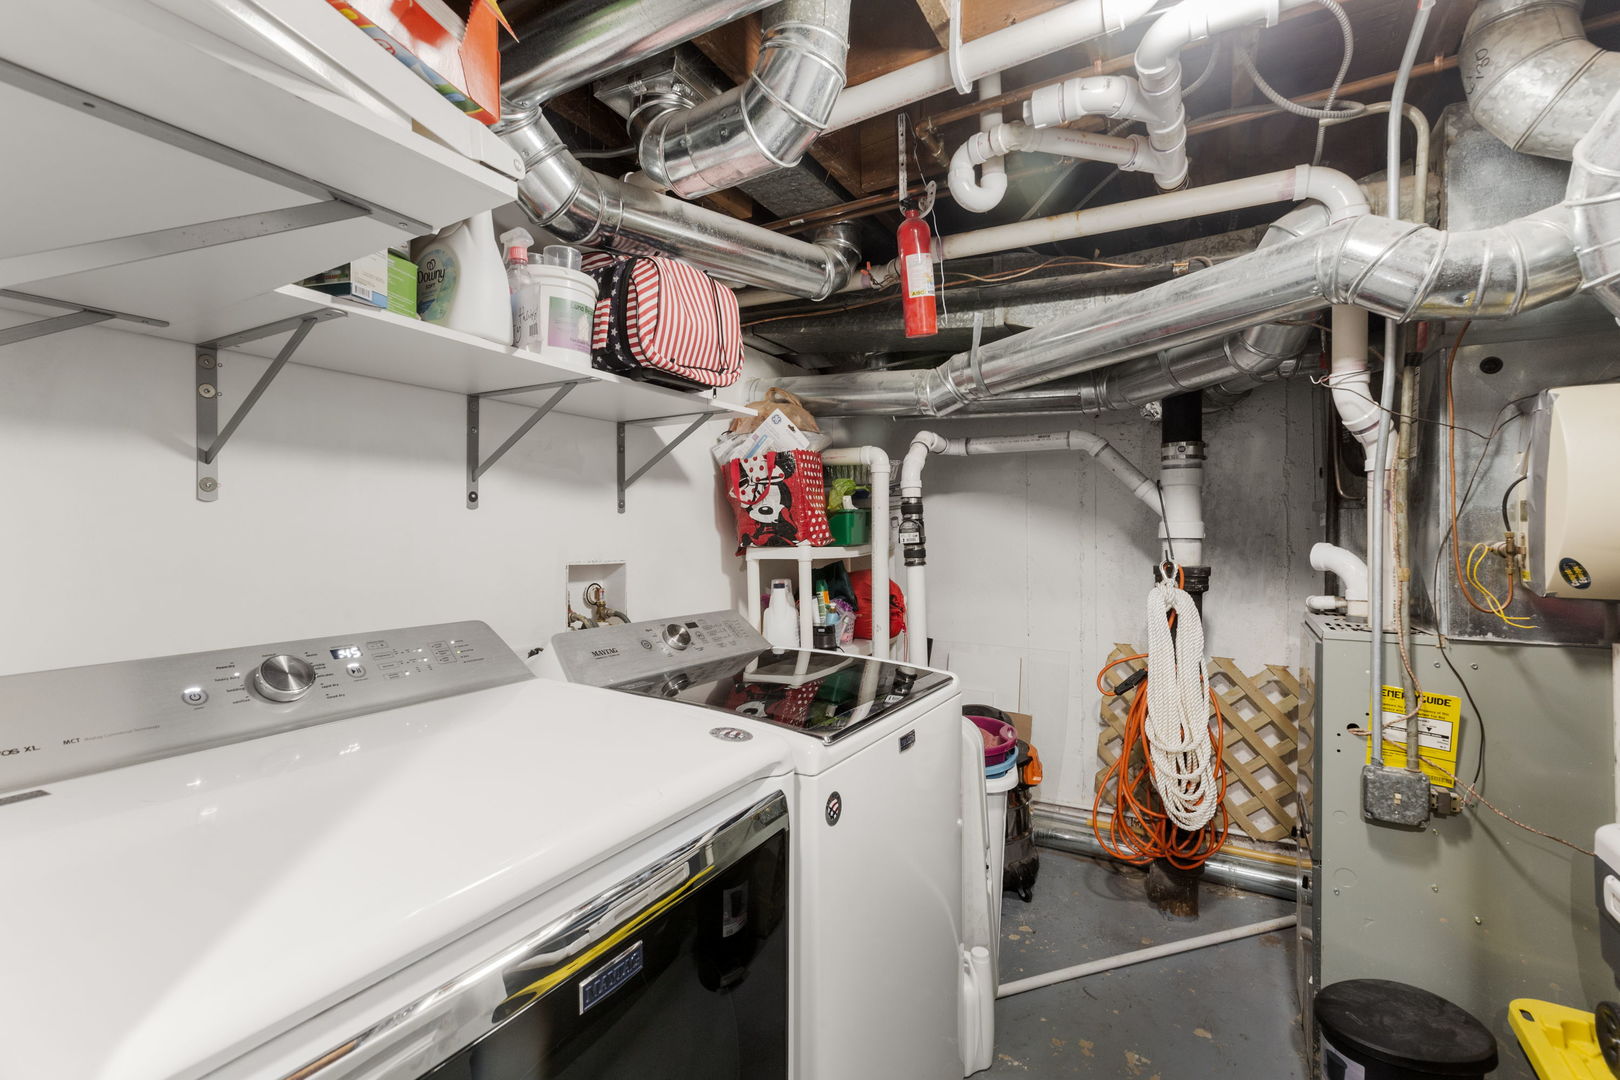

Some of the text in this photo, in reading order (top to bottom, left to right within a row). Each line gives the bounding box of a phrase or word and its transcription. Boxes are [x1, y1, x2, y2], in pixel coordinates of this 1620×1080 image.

[417, 268, 446, 284] Downy
[591, 647, 619, 657] MAYTAG
[62, 737, 81, 746] MCT
[23, 745, 41, 753] XL
